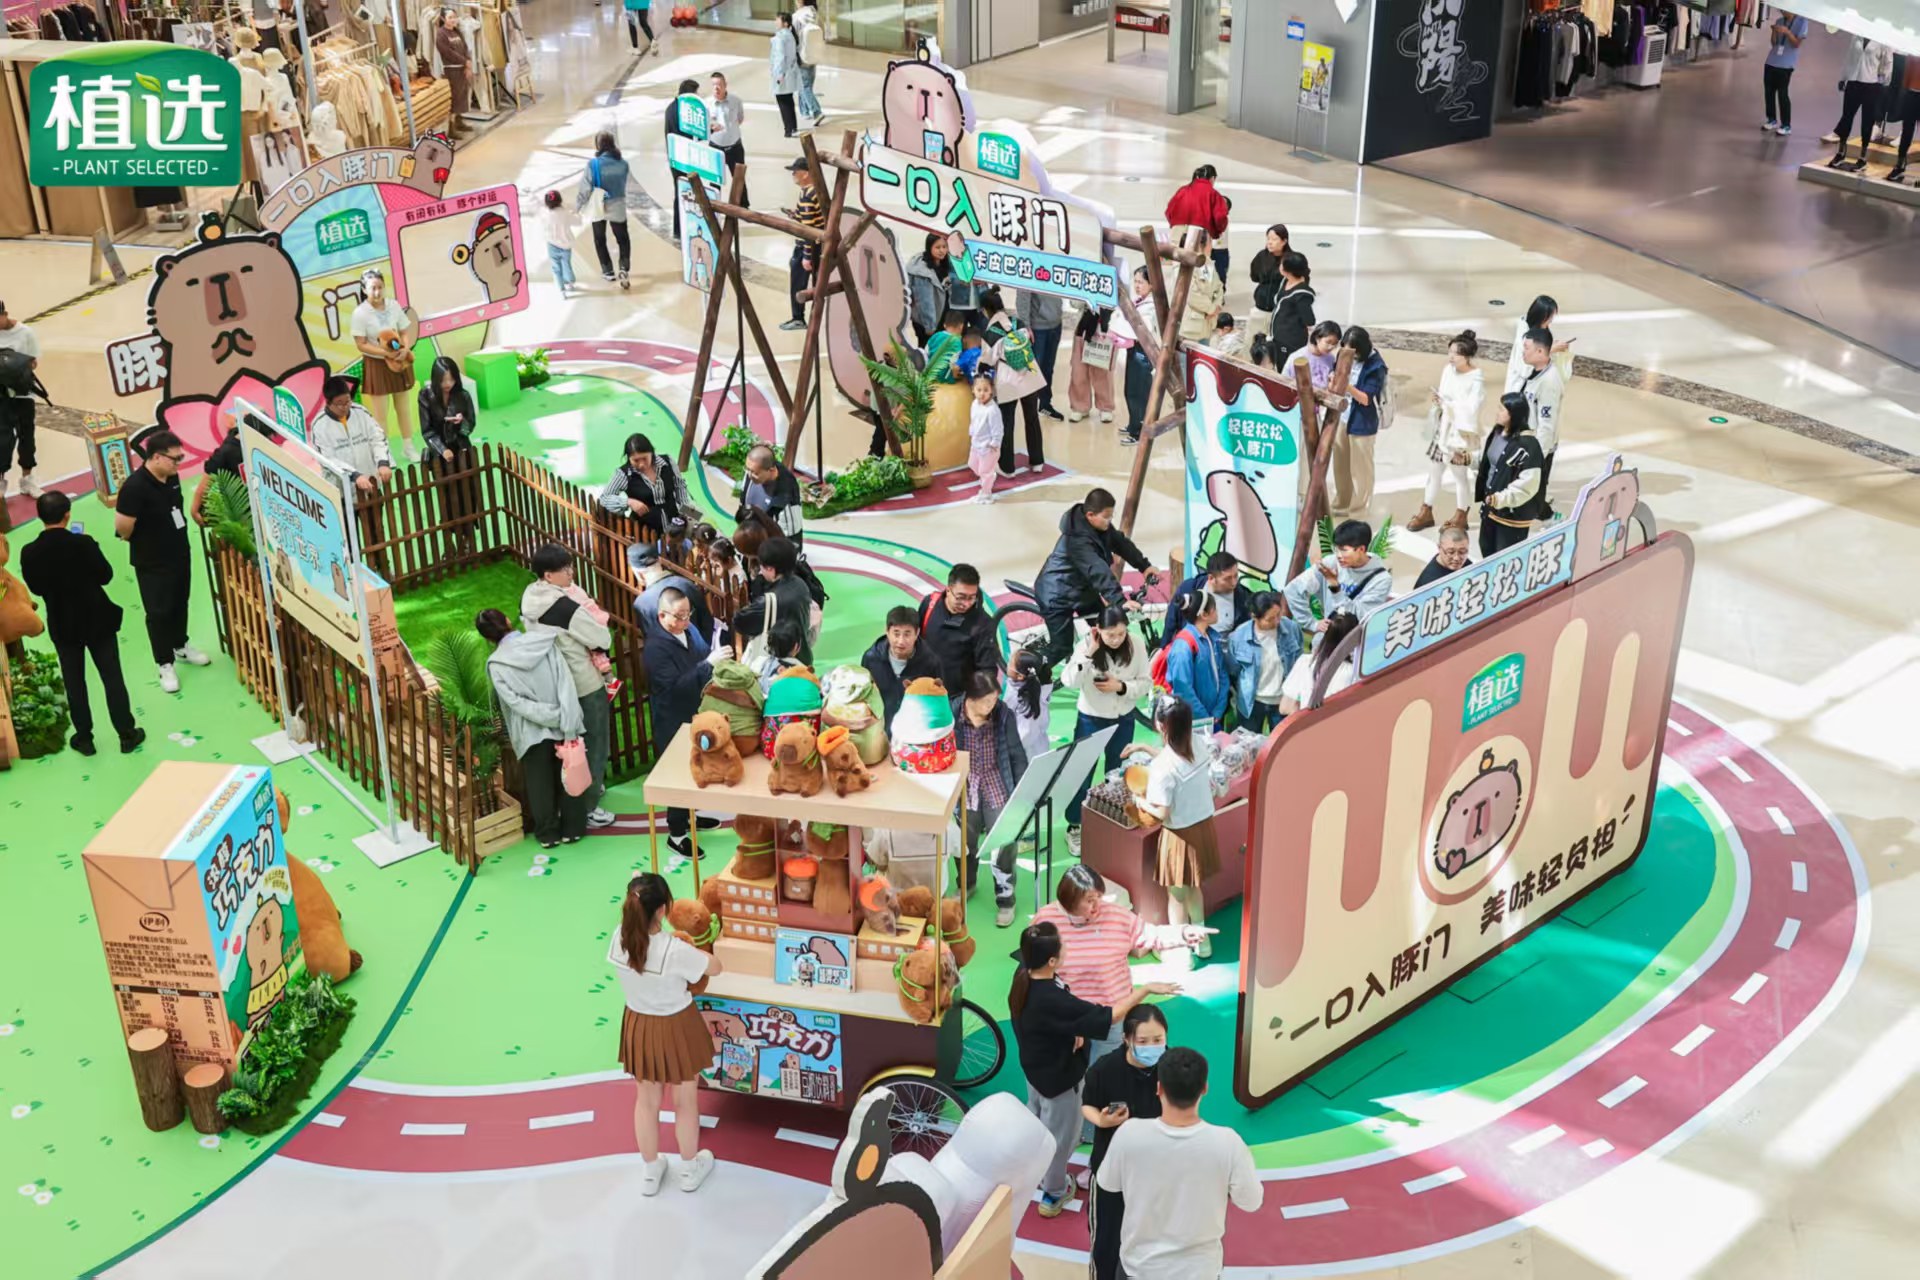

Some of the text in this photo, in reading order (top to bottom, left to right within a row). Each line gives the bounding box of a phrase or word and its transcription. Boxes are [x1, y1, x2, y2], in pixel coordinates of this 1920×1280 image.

[981, 138, 1018, 170] 植选
[269, 152, 394, 223] 一口入豚门
[867, 163, 1070, 254] 一口入豚门
[320, 214, 368, 246] 植选
[110, 335, 168, 394] 豚
[276, 394, 305, 436] 植选
[1228, 418, 1284, 441] 轻轻松松
[258, 461, 328, 530] WELCOME
[1384, 533, 1566, 660] 美味轻松豚
[1467, 663, 1521, 717] 植选
[1480, 818, 1617, 935] 美味轻负担
[143, 914, 166, 927] 伊利
[749, 1015, 832, 1058] 巧克力
